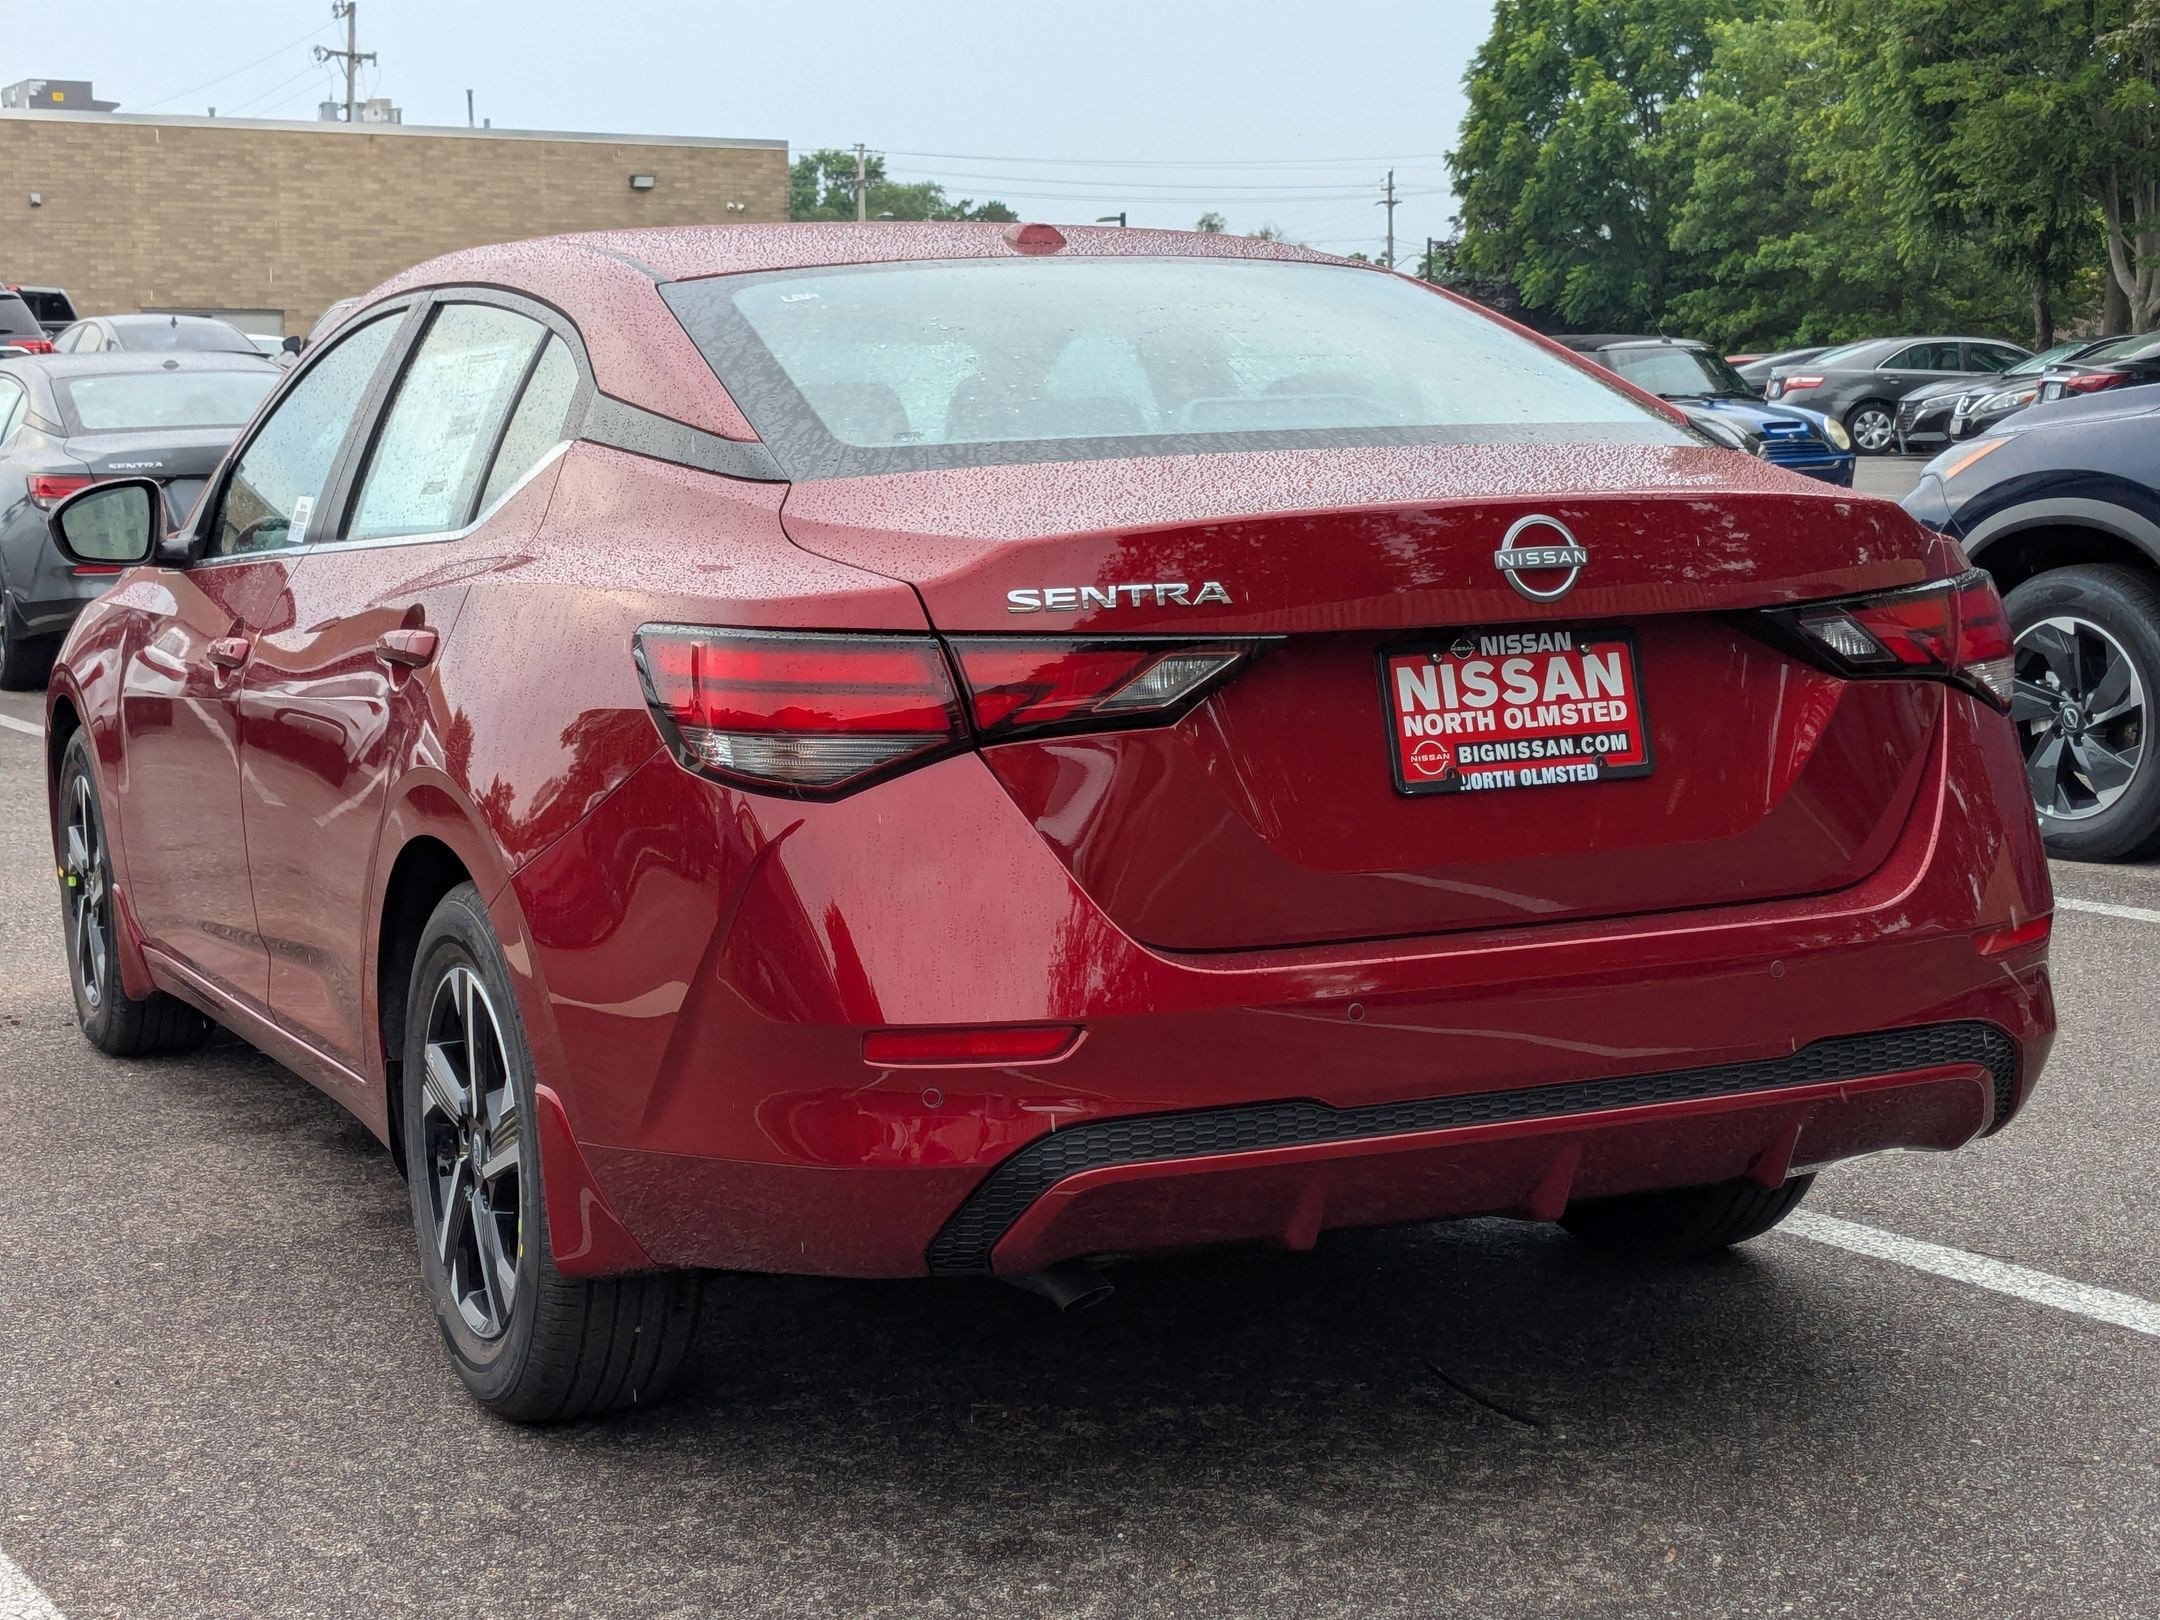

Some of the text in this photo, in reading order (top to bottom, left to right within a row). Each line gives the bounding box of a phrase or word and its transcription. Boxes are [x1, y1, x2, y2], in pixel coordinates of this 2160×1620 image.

[108, 461, 163, 469] SENTRA
[1498, 550, 1587, 567] NISSAN
[1007, 581, 1233, 613] SENTRA
[1480, 631, 1572, 656] NISSAN
[1396, 652, 1625, 712] NISSAN
[1403, 700, 1628, 737] NORTH OLMSTED
[1410, 753, 1450, 763] NISSAN
[1458, 733, 1628, 764] BIGNISSAN.COM
[1520, 763, 1599, 786] OLMSTED
